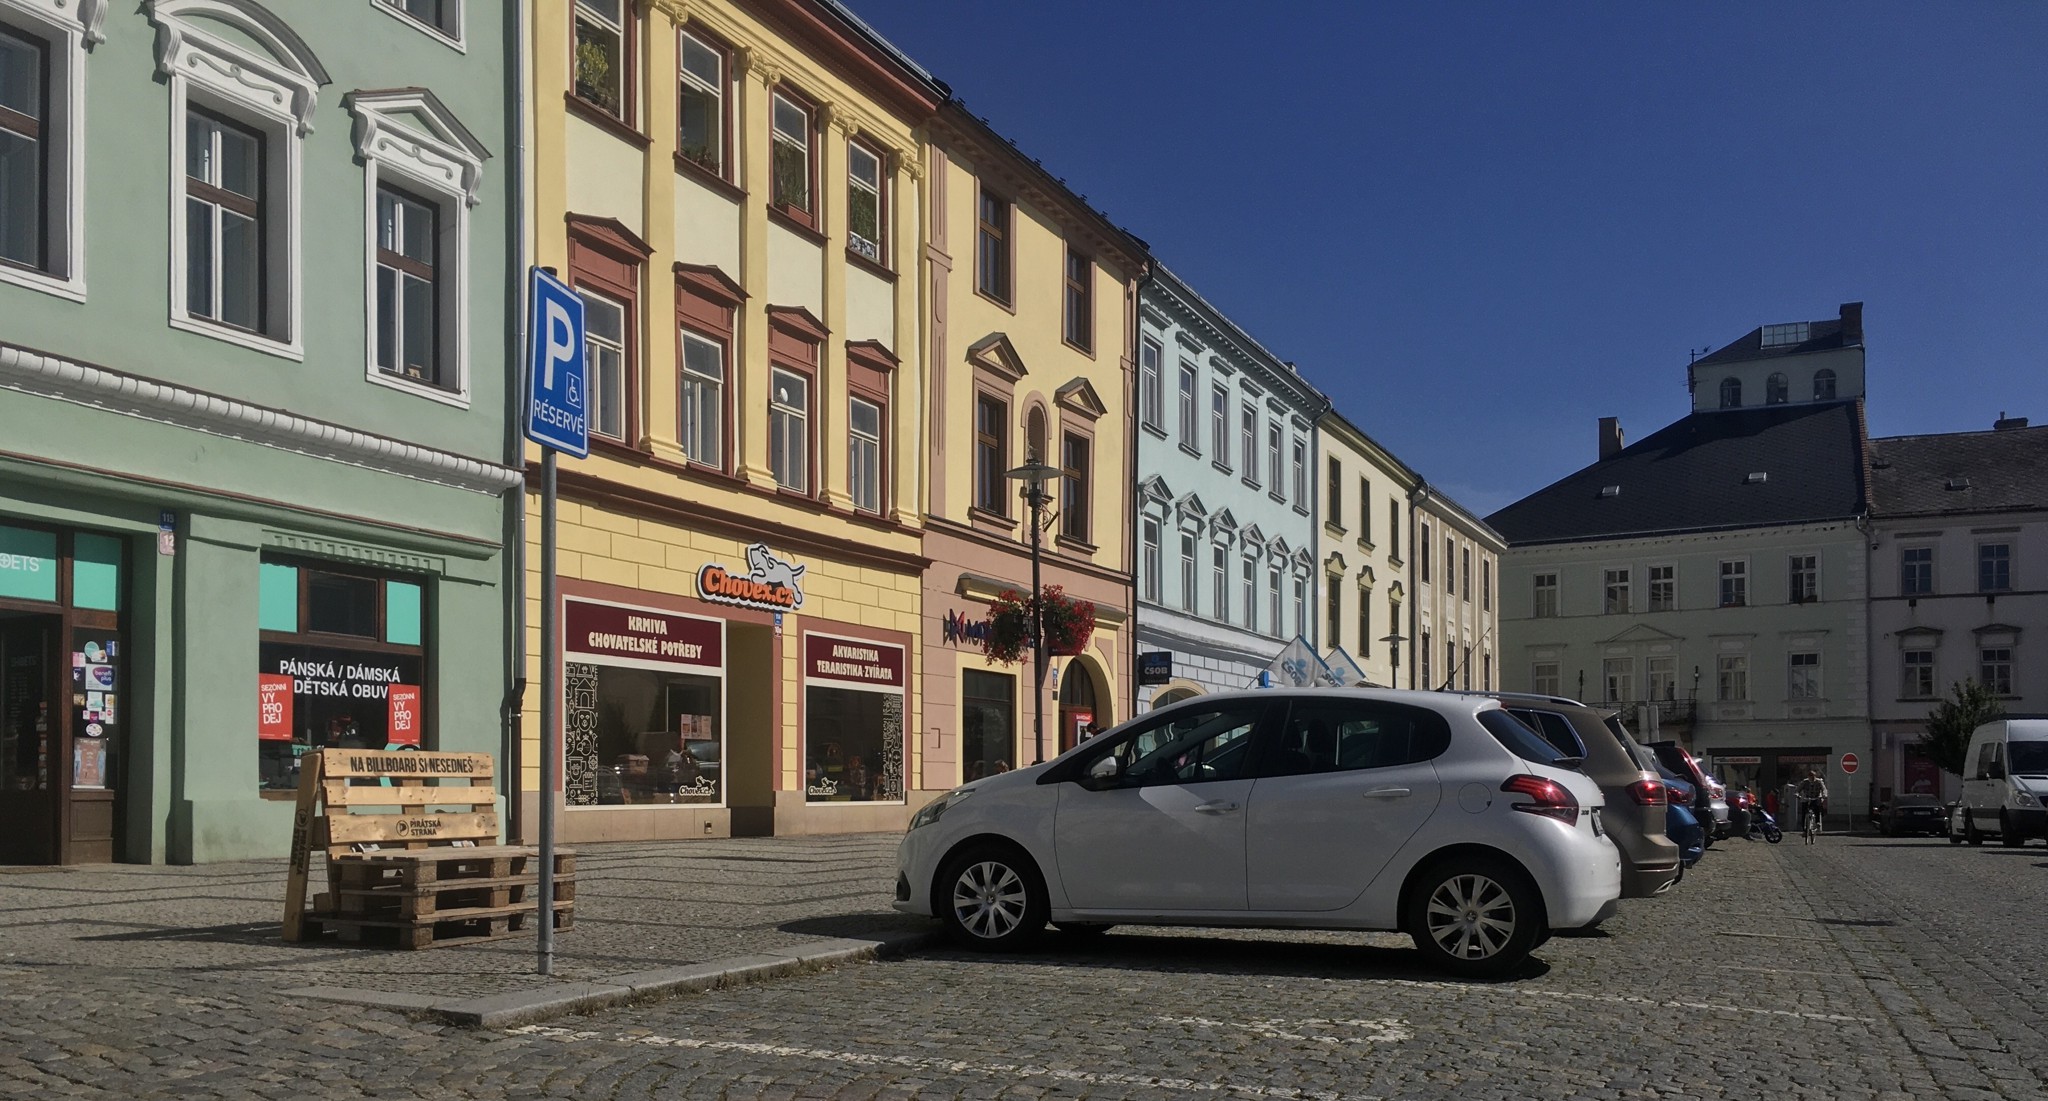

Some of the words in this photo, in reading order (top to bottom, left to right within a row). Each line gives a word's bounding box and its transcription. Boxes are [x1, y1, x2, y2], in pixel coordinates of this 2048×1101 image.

[544, 297, 575, 391] P
[534, 398, 584, 436] RÉSERVÉ
[705, 567, 794, 605] Chovex.cz
[628, 615, 668, 635] KRMIVA
[588, 631, 658, 654] CHOVATELSKÉ
[661, 640, 702, 659] POTŘEBY
[832, 644, 879, 662] AKVARISTIKA
[280, 658, 335, 678] PÁNSKÁ
[346, 663, 400, 683] DÁMSKÁ
[1144, 666, 1168, 675] ČSOB
[294, 677, 348, 696] DĚTSKÁ
[352, 684, 388, 699] OBUV
[262, 702, 283, 714] PRO
[394, 710, 411, 721] PRO
[263, 713, 282, 724] DEJ
[395, 720, 411, 730] DEJ
[350, 757, 364, 773] NA
[366, 757, 417, 773] BILLBOARD
[419, 758, 427, 773] SI
[429, 756, 474, 774] NESEDNEŠ
[410, 818, 441, 828] PIRÁTSKÁ
[410, 828, 437, 836] STRANA
